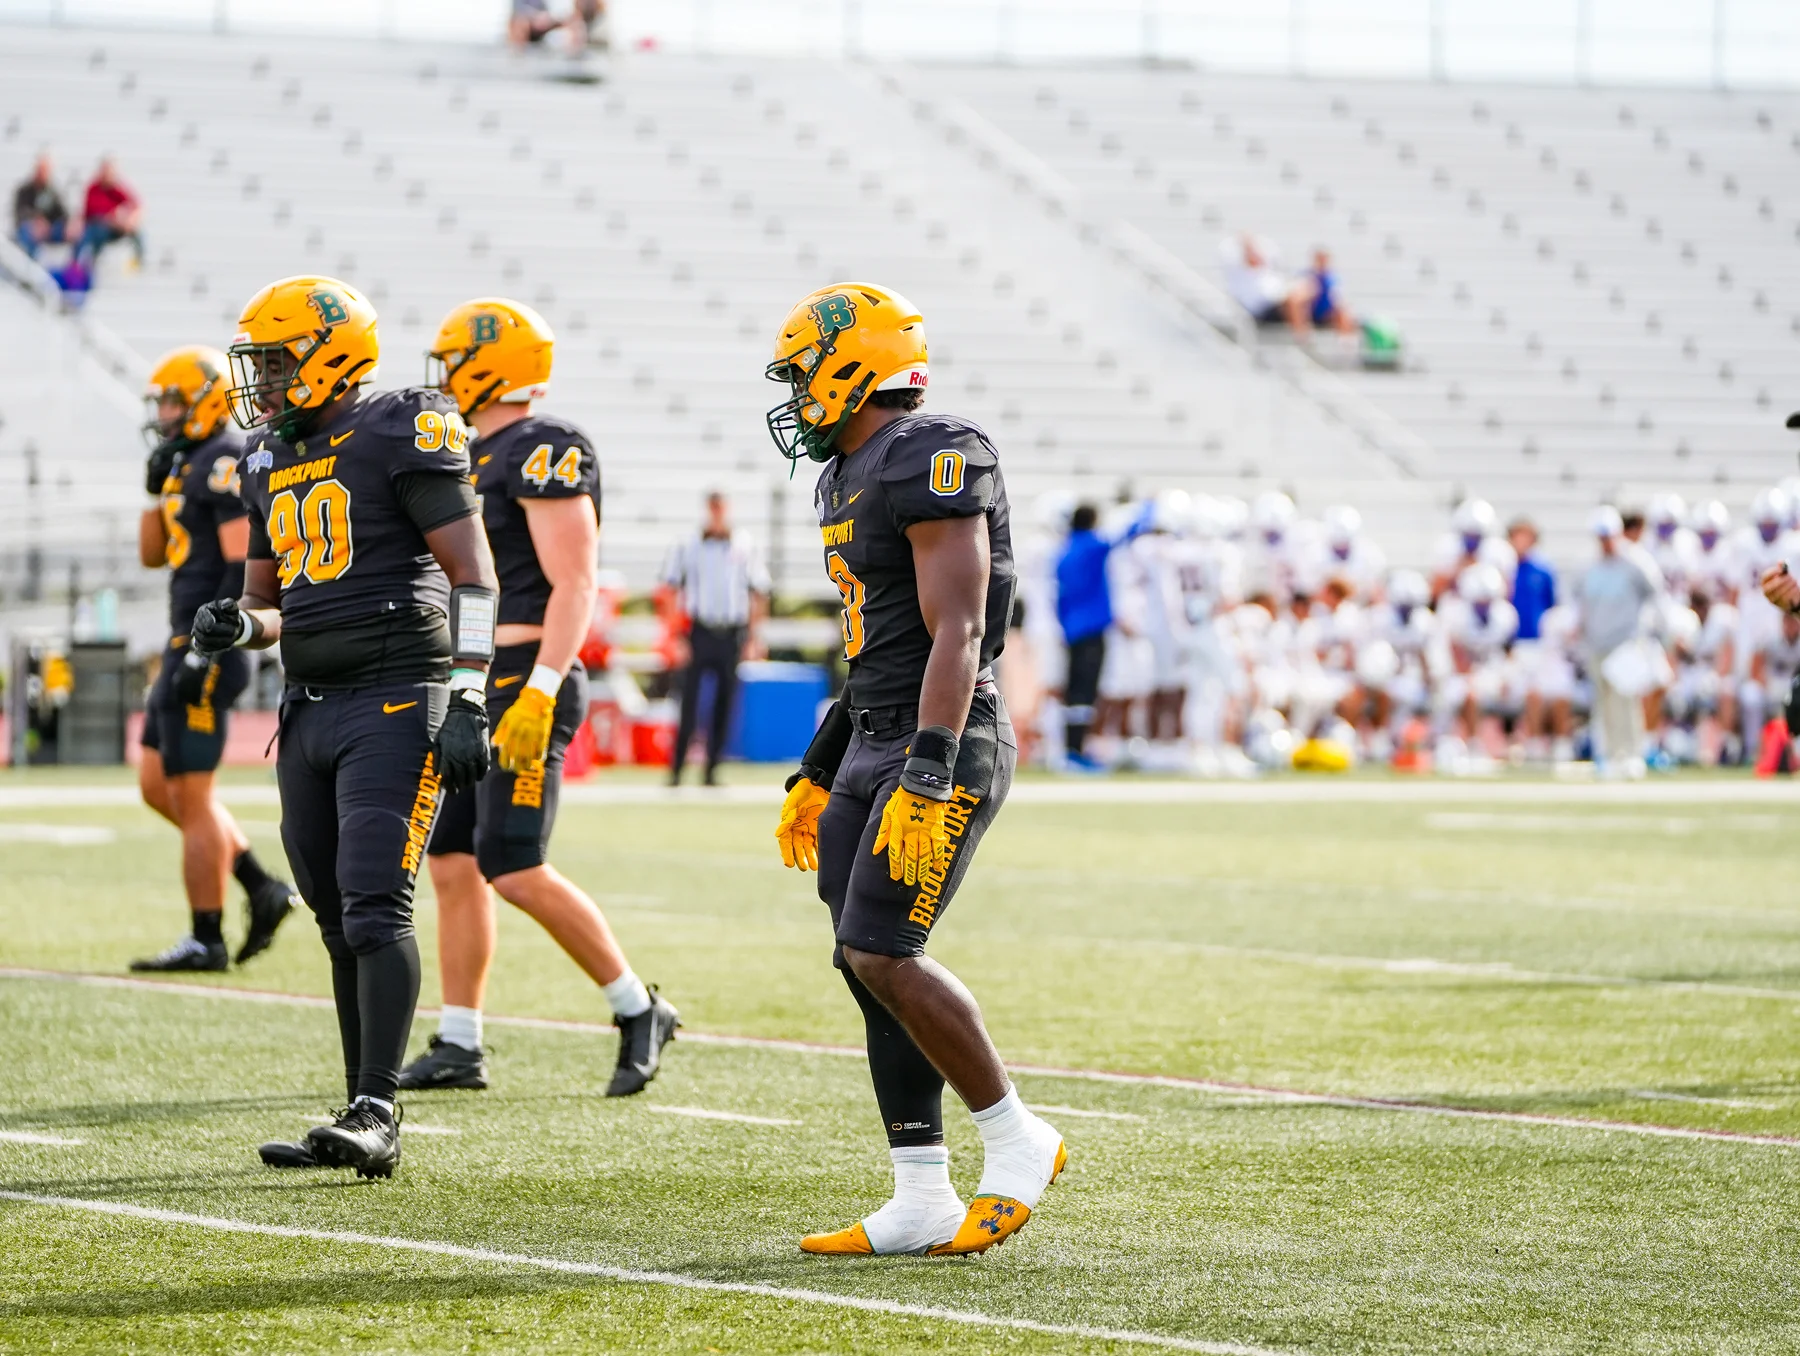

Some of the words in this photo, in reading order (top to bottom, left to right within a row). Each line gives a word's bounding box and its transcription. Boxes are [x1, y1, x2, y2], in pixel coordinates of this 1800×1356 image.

[308, 290, 350, 328] B
[471, 315, 499, 344] B
[811, 294, 857, 340] B
[414, 411, 467, 454] 90
[268, 456, 337, 494] BROCKPORT
[521, 444, 582, 488] 44
[930, 449, 966, 496] 0
[267, 479, 353, 589] 90
